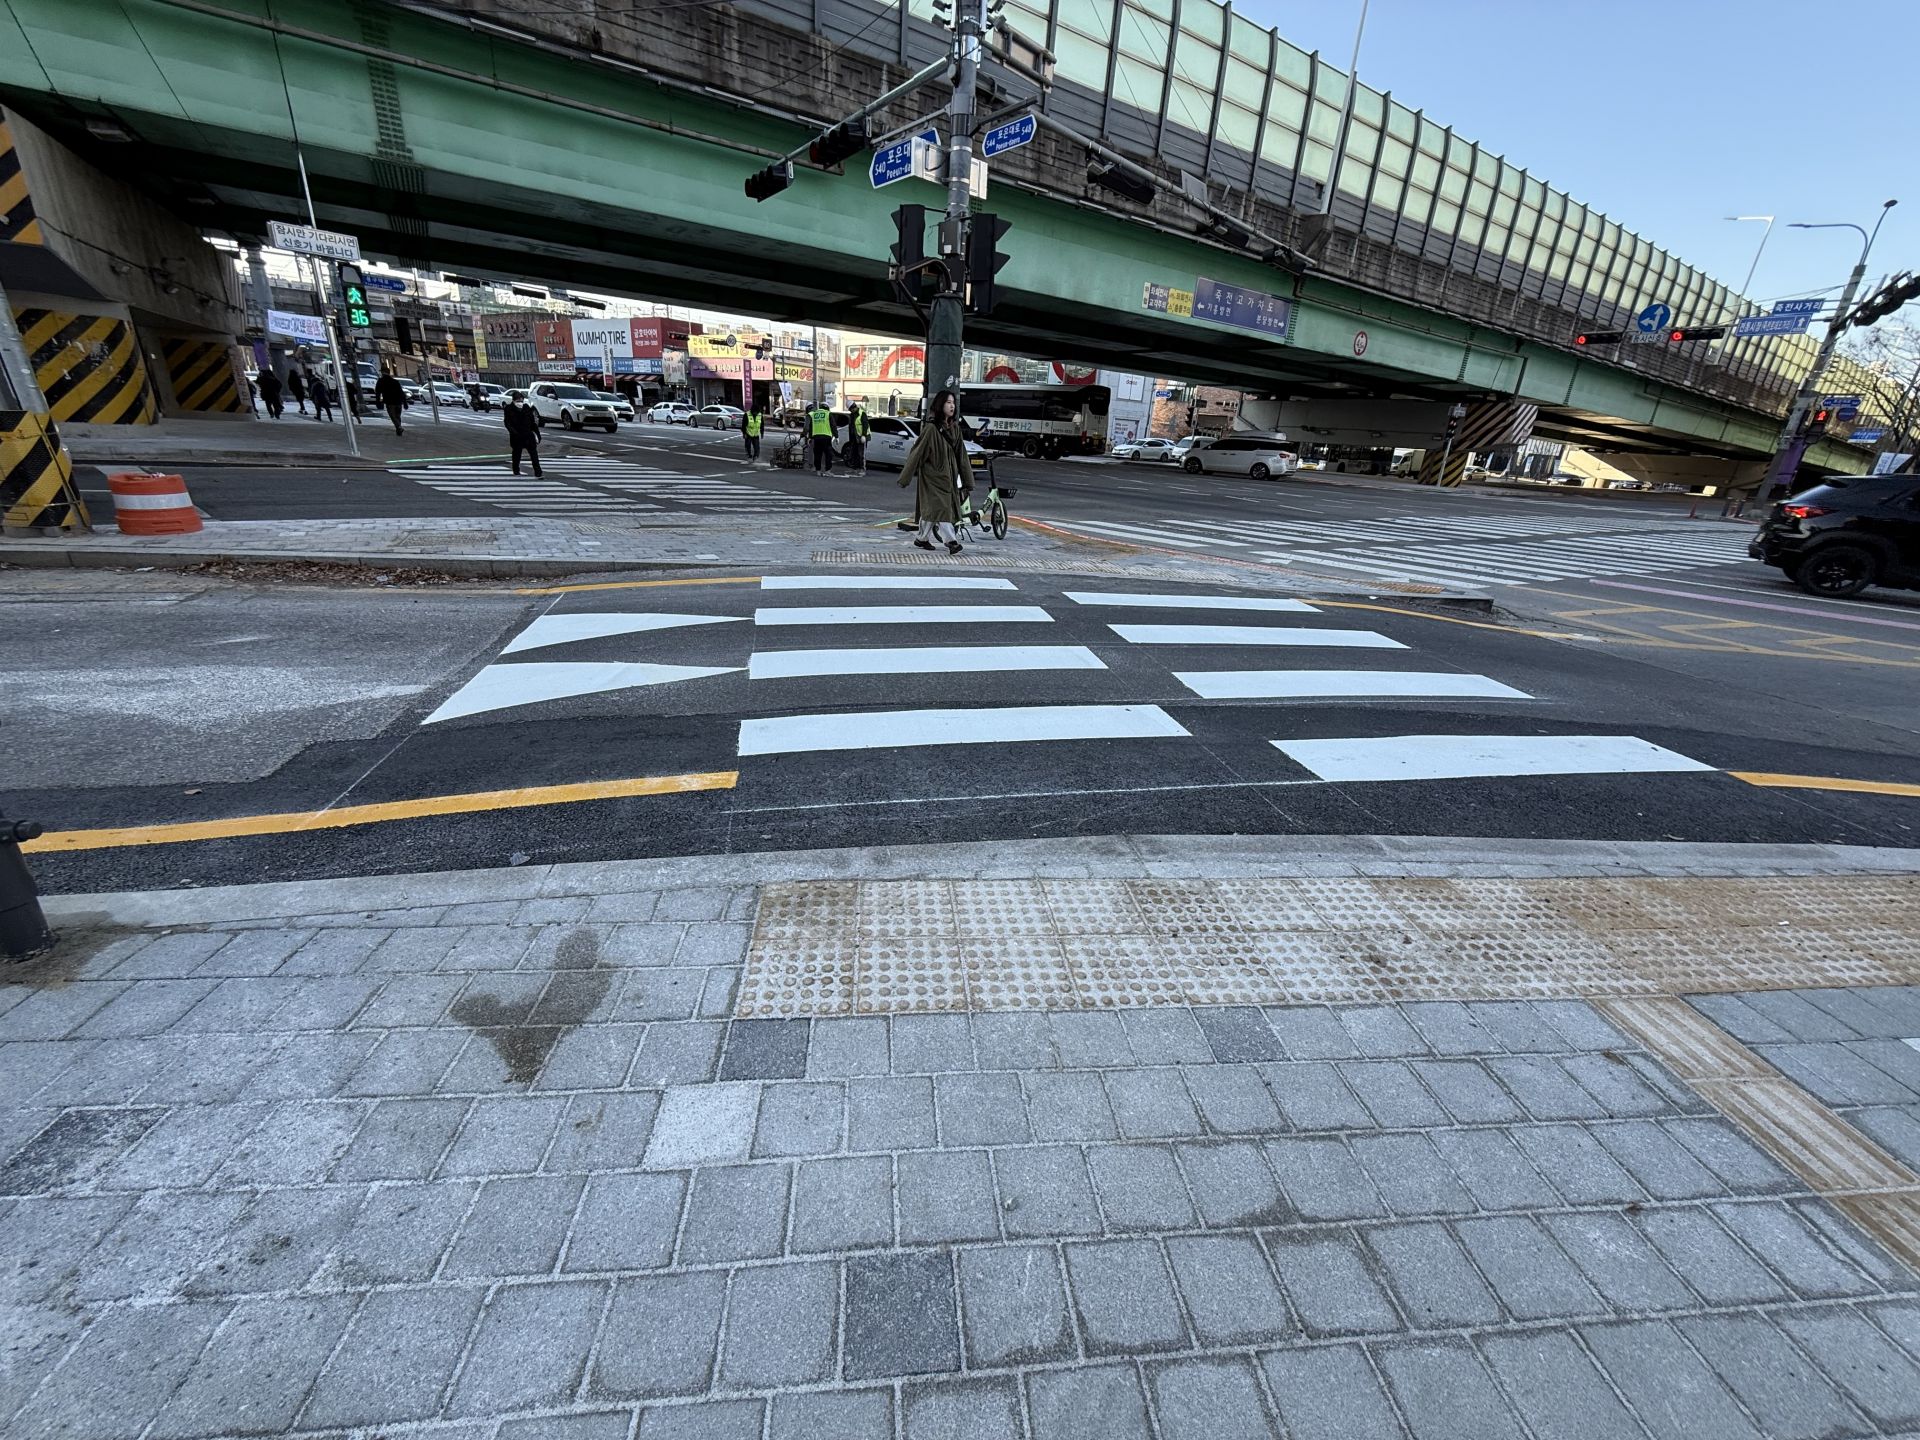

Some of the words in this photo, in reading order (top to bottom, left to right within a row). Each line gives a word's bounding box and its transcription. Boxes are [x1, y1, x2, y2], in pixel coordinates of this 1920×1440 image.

[997, 122, 1021, 139] 포은대로
[1021, 124, 1032, 136] 548
[986, 138, 996, 149] 544
[874, 161, 886, 176] 540
[887, 142, 911, 164] 포은대
[886, 163, 911, 180] Poeun-da
[276, 224, 306, 239] 잠시만
[308, 230, 356, 248] 기다리시면
[283, 238, 313, 251] 신호가
[316, 244, 354, 259] 바뀝니다
[1776, 301, 1822, 312] 죽전사거리
[351, 308, 370, 325] 36
[577, 331, 607, 345] KUMHO
[609, 330, 627, 345] TIRE
[775, 366, 799, 379] 타이어
[1020, 422, 1032, 431] H2
